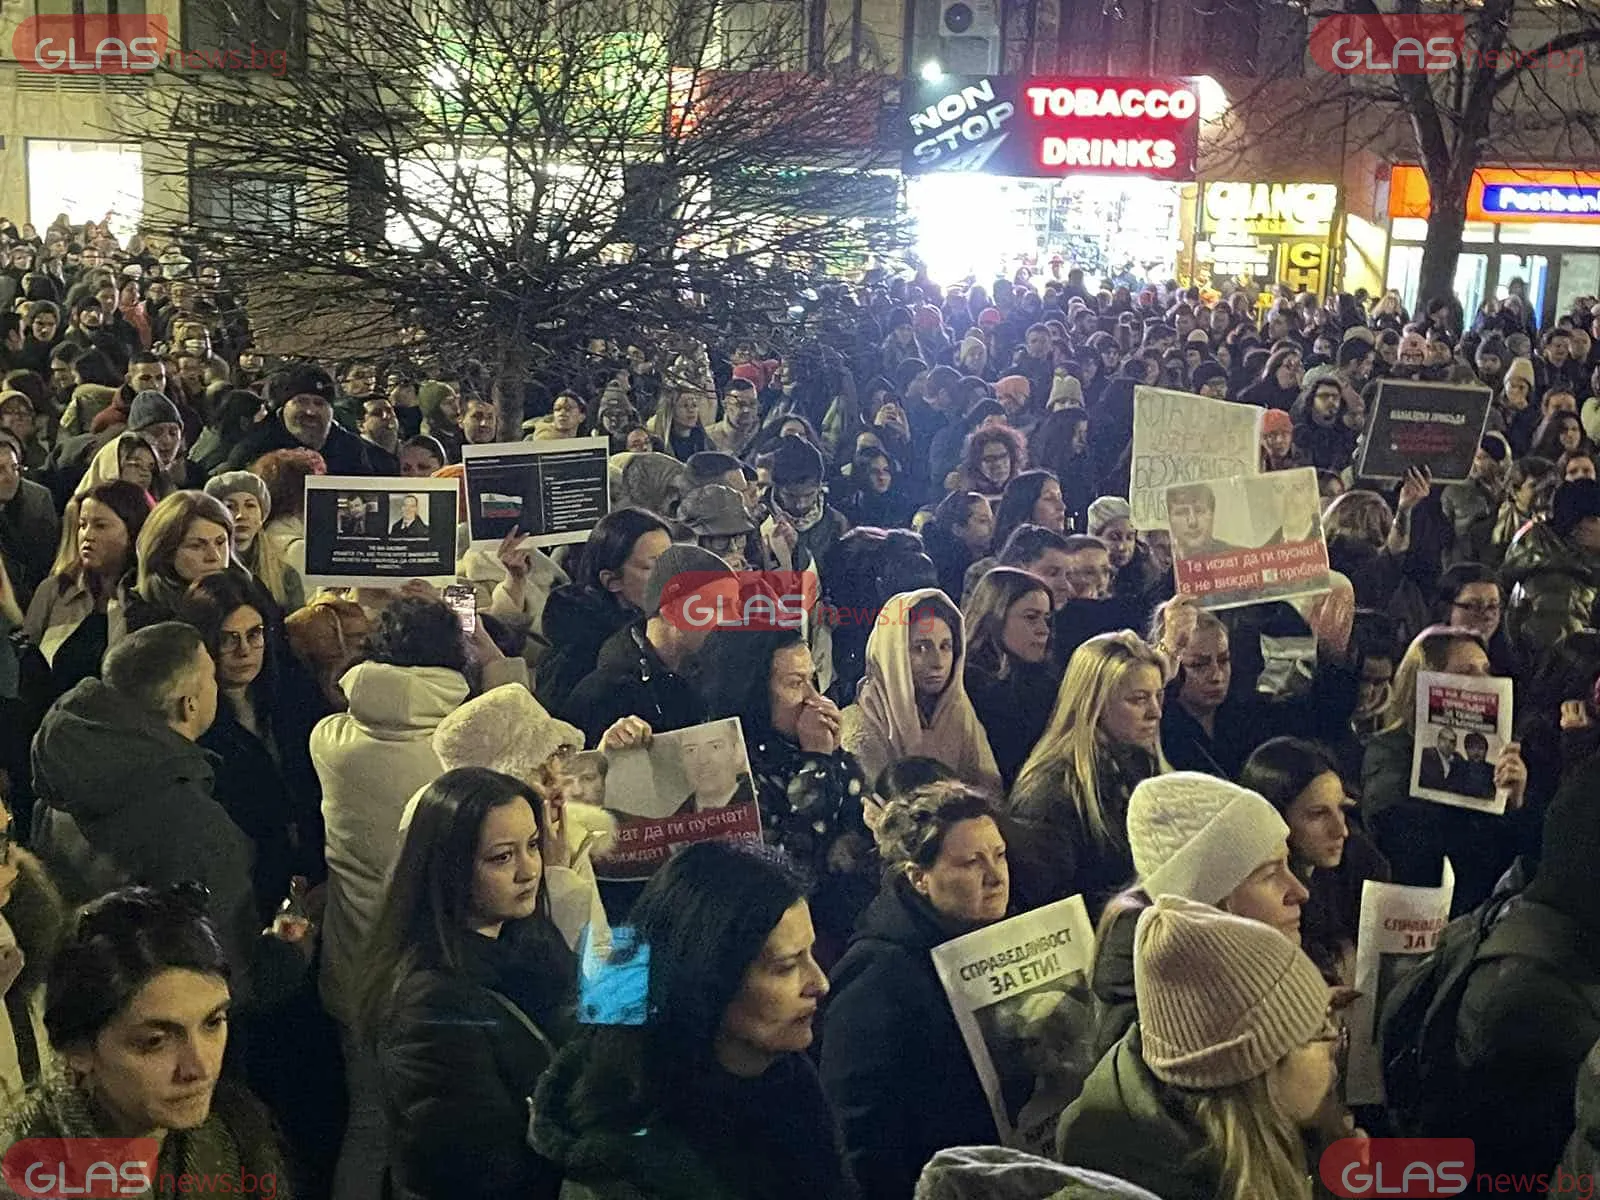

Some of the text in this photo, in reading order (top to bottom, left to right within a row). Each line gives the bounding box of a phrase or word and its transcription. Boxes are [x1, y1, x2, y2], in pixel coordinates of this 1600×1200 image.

[908, 79, 995, 136] NON
[1027, 87, 1196, 119] TOBACCO
[913, 101, 1014, 165] STOP
[1042, 137, 1176, 168] DRINKS
[1500, 187, 1600, 213] Postban
[1242, 554, 1260, 568] да
[1195, 579, 1211, 591] не
[1214, 573, 1259, 589] виждат
[643, 824, 664, 842] да
[667, 821, 685, 835] ги
[960, 928, 1071, 981] СПРАВЕДЛИВОСТ
[988, 953, 1060, 995] ЗА ЕТИ!
